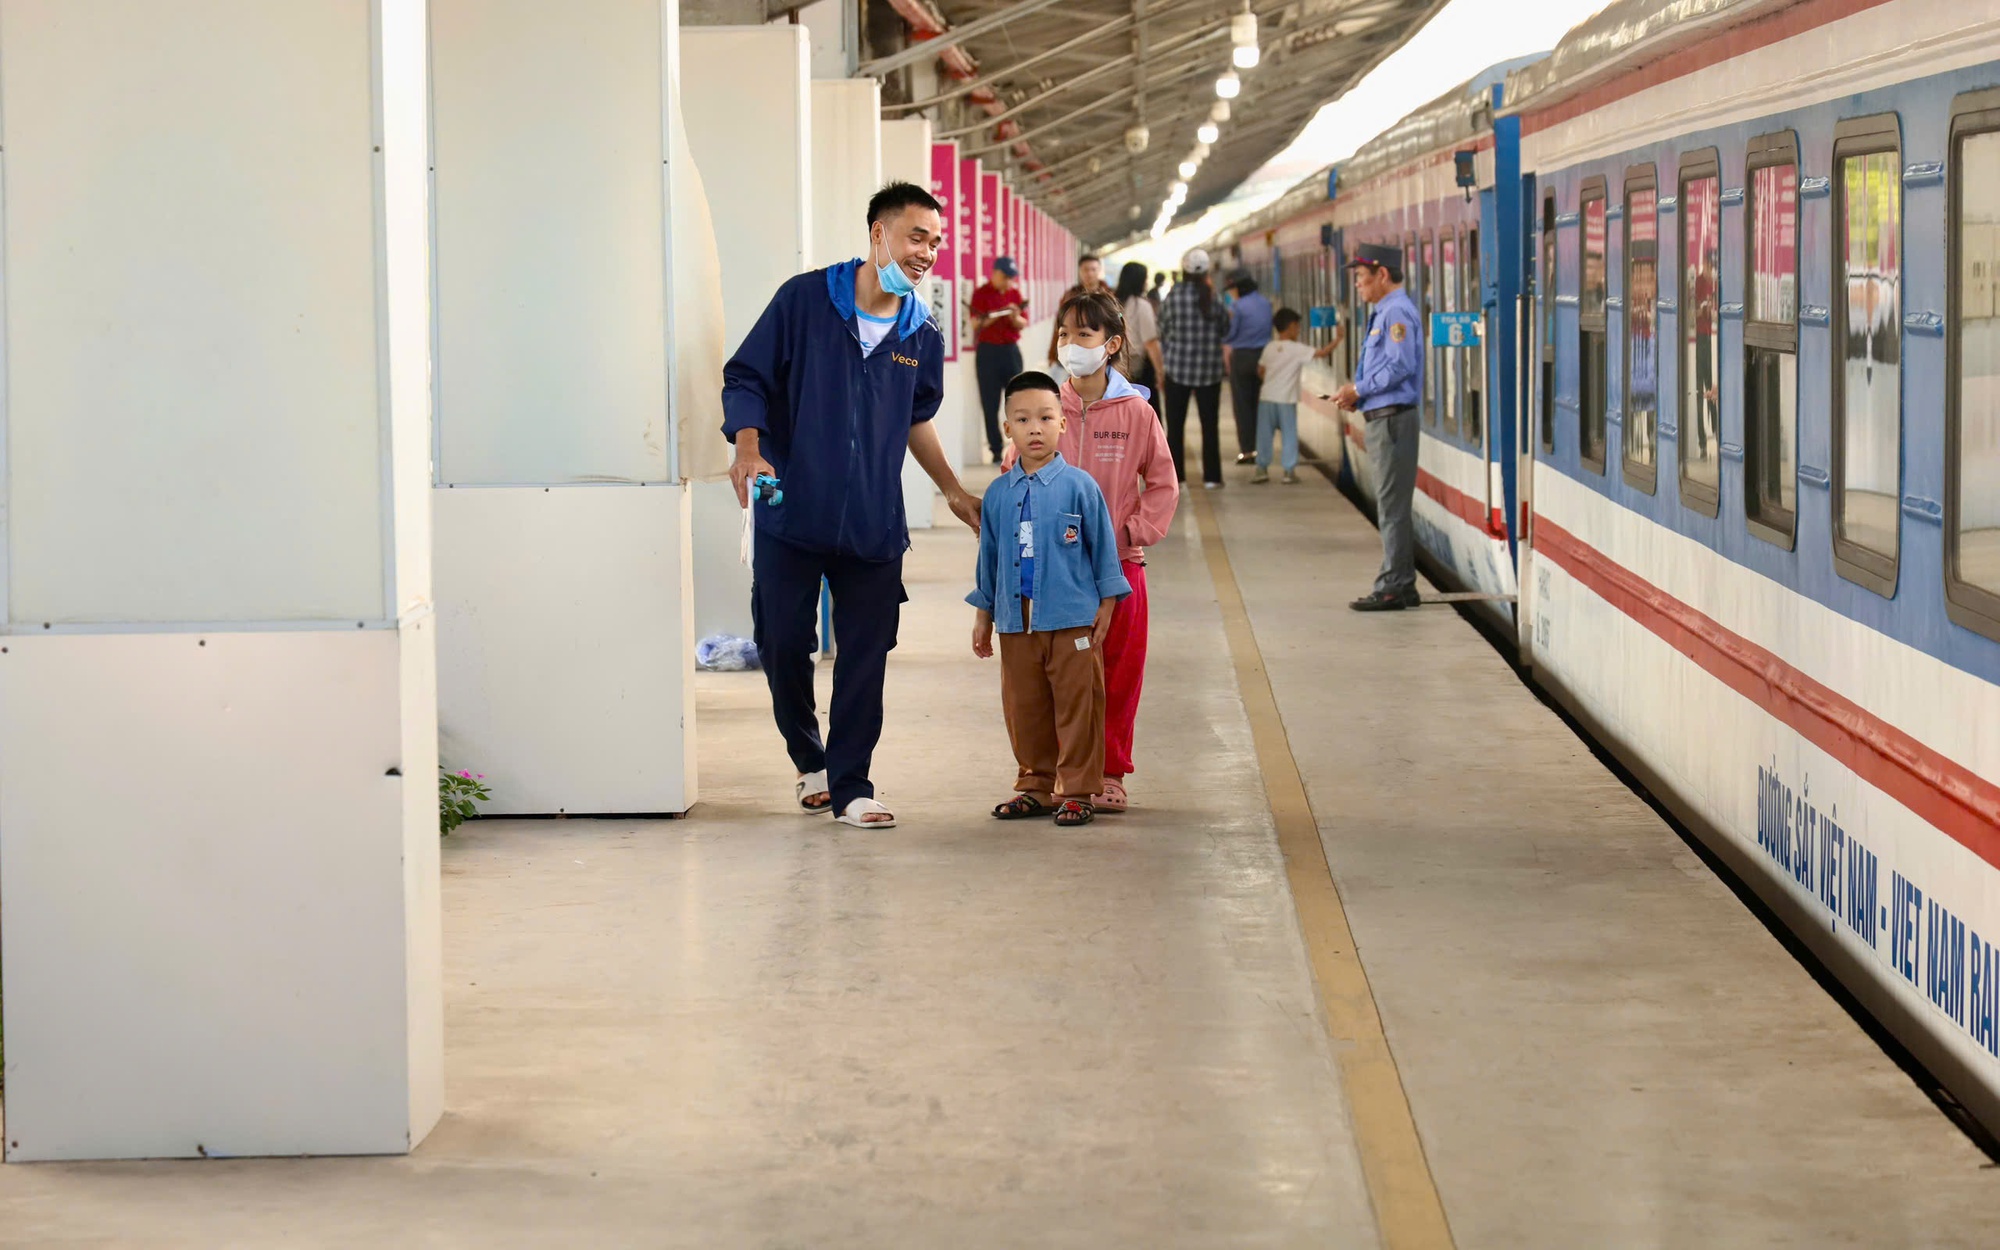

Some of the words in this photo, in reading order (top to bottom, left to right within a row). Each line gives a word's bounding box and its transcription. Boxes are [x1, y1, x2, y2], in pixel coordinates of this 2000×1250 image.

[1449, 323, 1463, 346] 6
[891, 351, 918, 367] Veco
[1757, 753, 1792, 873] ĐƯỜNG
[1794, 772, 1816, 893] SẮT
[1820, 803, 1844, 933] VIỆT
[1848, 835, 1877, 950] NAM
[1892, 869, 1922, 988] VIET
[1927, 897, 1965, 1028] NAM
